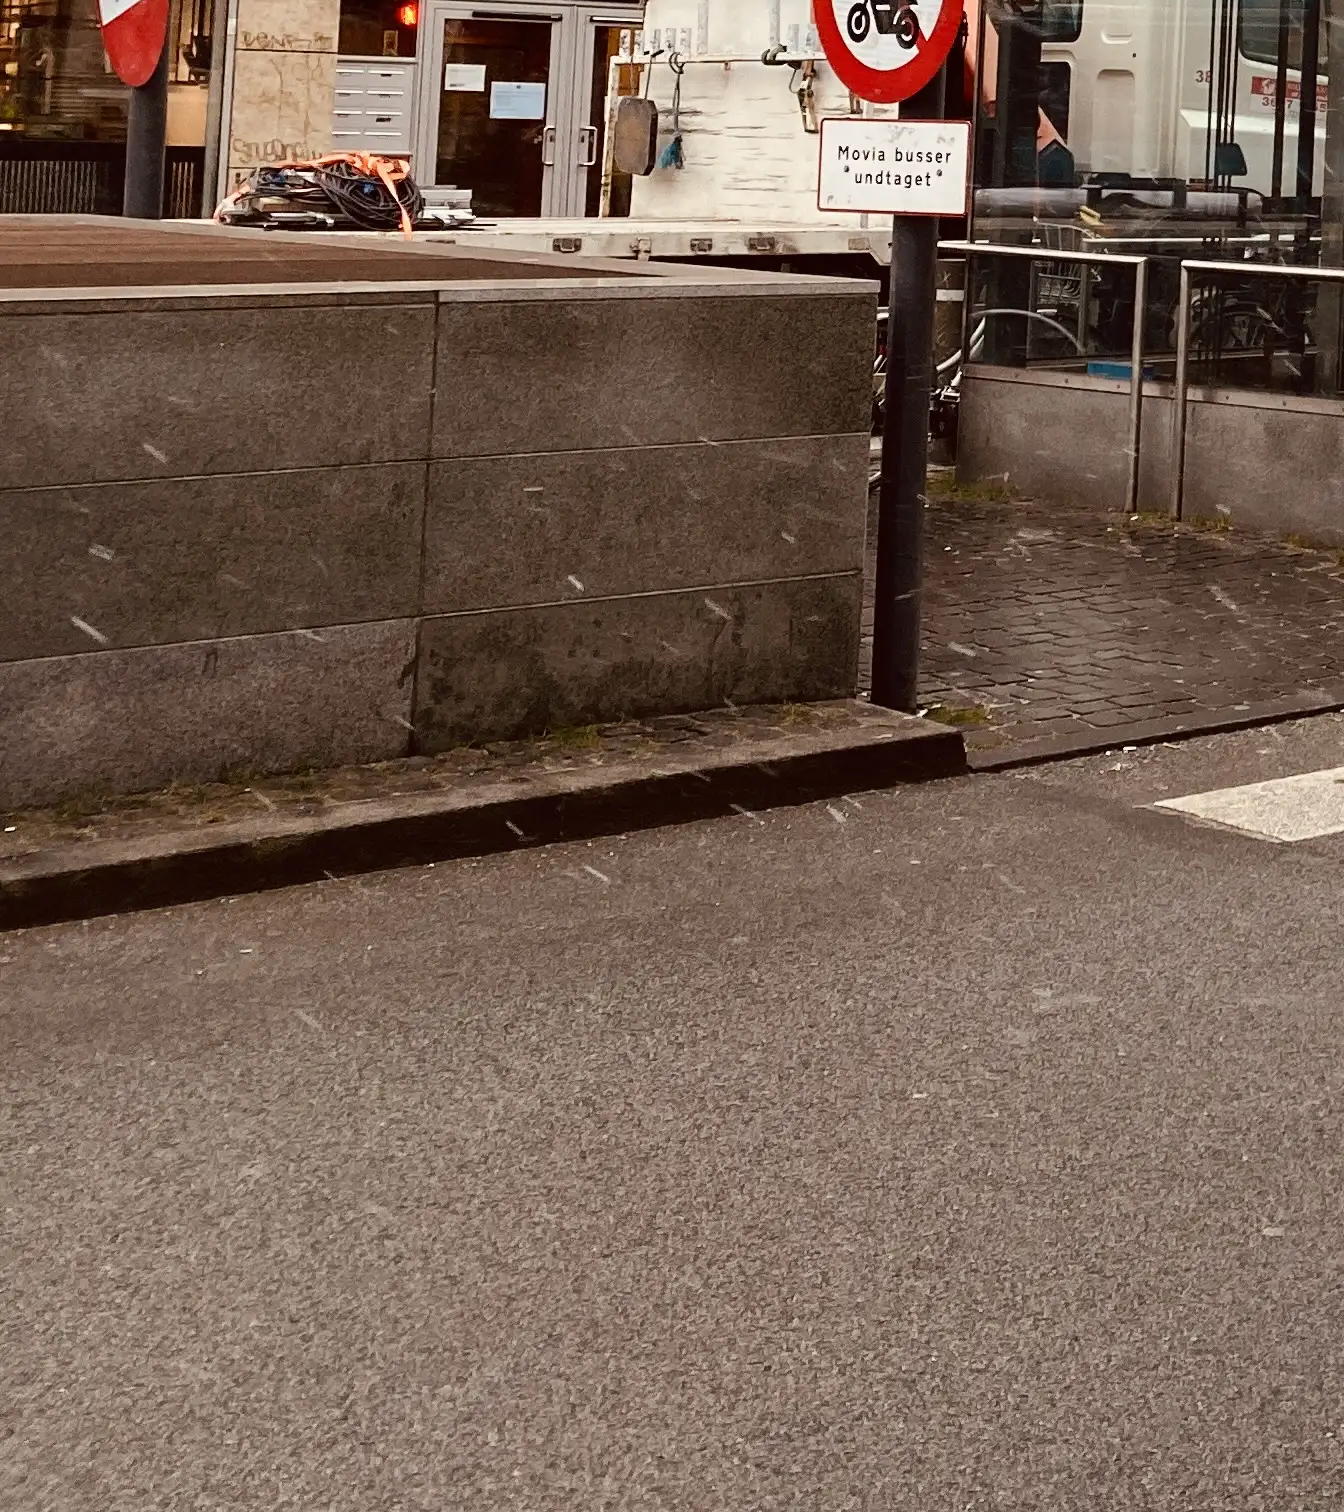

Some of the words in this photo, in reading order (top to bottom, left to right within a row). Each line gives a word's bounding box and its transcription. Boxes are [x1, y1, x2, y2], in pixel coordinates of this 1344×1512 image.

[837, 145, 885, 162] Movia
[895, 147, 952, 164] busser
[854, 170, 931, 189] undtaget
